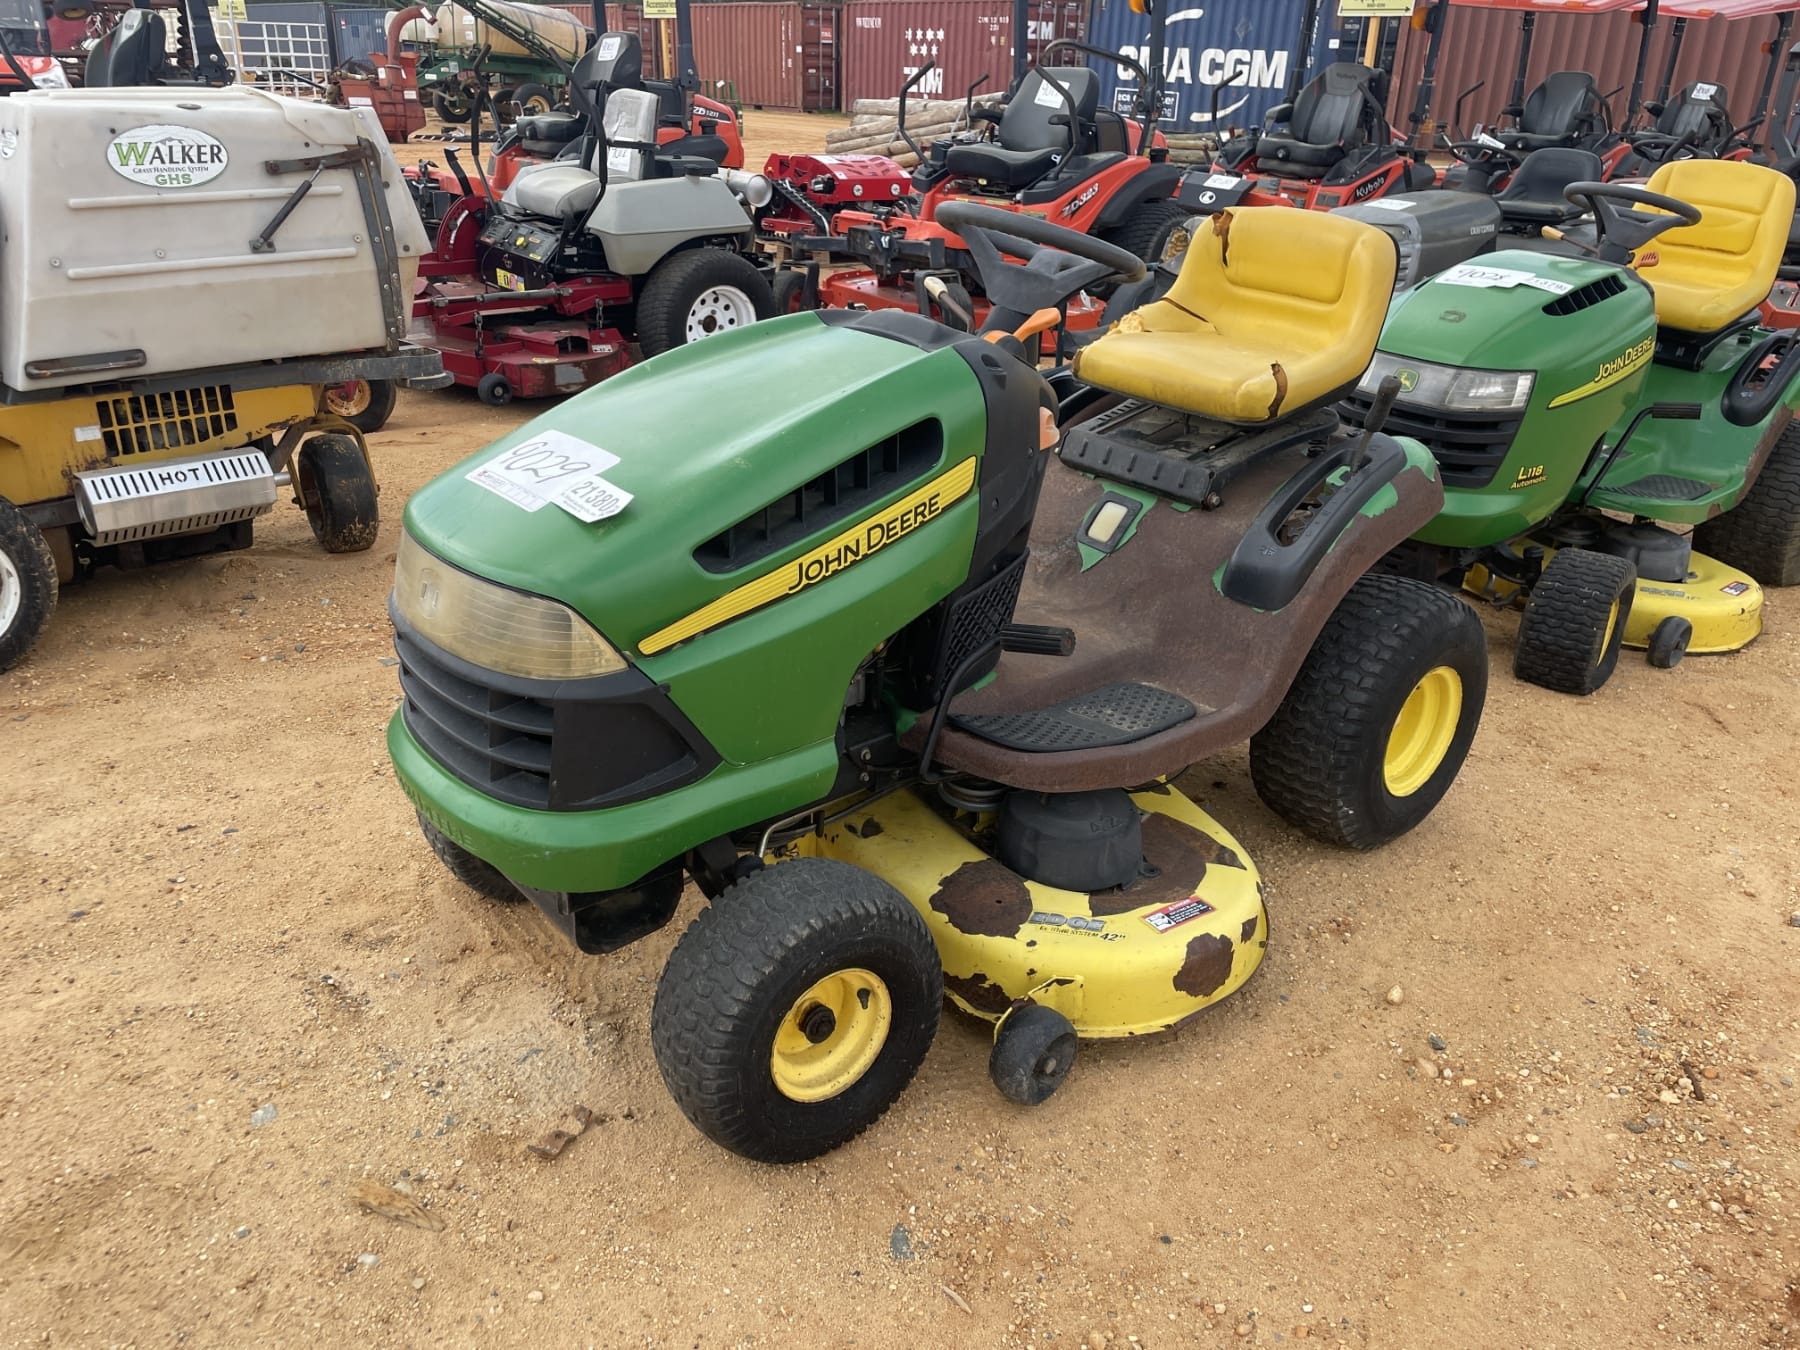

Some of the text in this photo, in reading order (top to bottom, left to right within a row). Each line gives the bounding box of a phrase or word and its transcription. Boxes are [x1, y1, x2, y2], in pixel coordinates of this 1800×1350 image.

[904, 66, 943, 94] ZIM
[1198, 48, 1288, 89] CGM
[114, 141, 223, 167] WALKER
[155, 173, 192, 185] GHS
[1356, 177, 1385, 198] Kubota
[1594, 336, 1653, 382] JOHN DEERE
[500, 441, 591, 484] 9029
[1518, 465, 1544, 480] L118
[158, 467, 199, 486] HOT
[571, 480, 618, 513] 21380
[788, 493, 940, 591] JOHN DEERE
[1028, 911, 1106, 932] EDGE
[1070, 930, 1099, 938] SYSTEM
